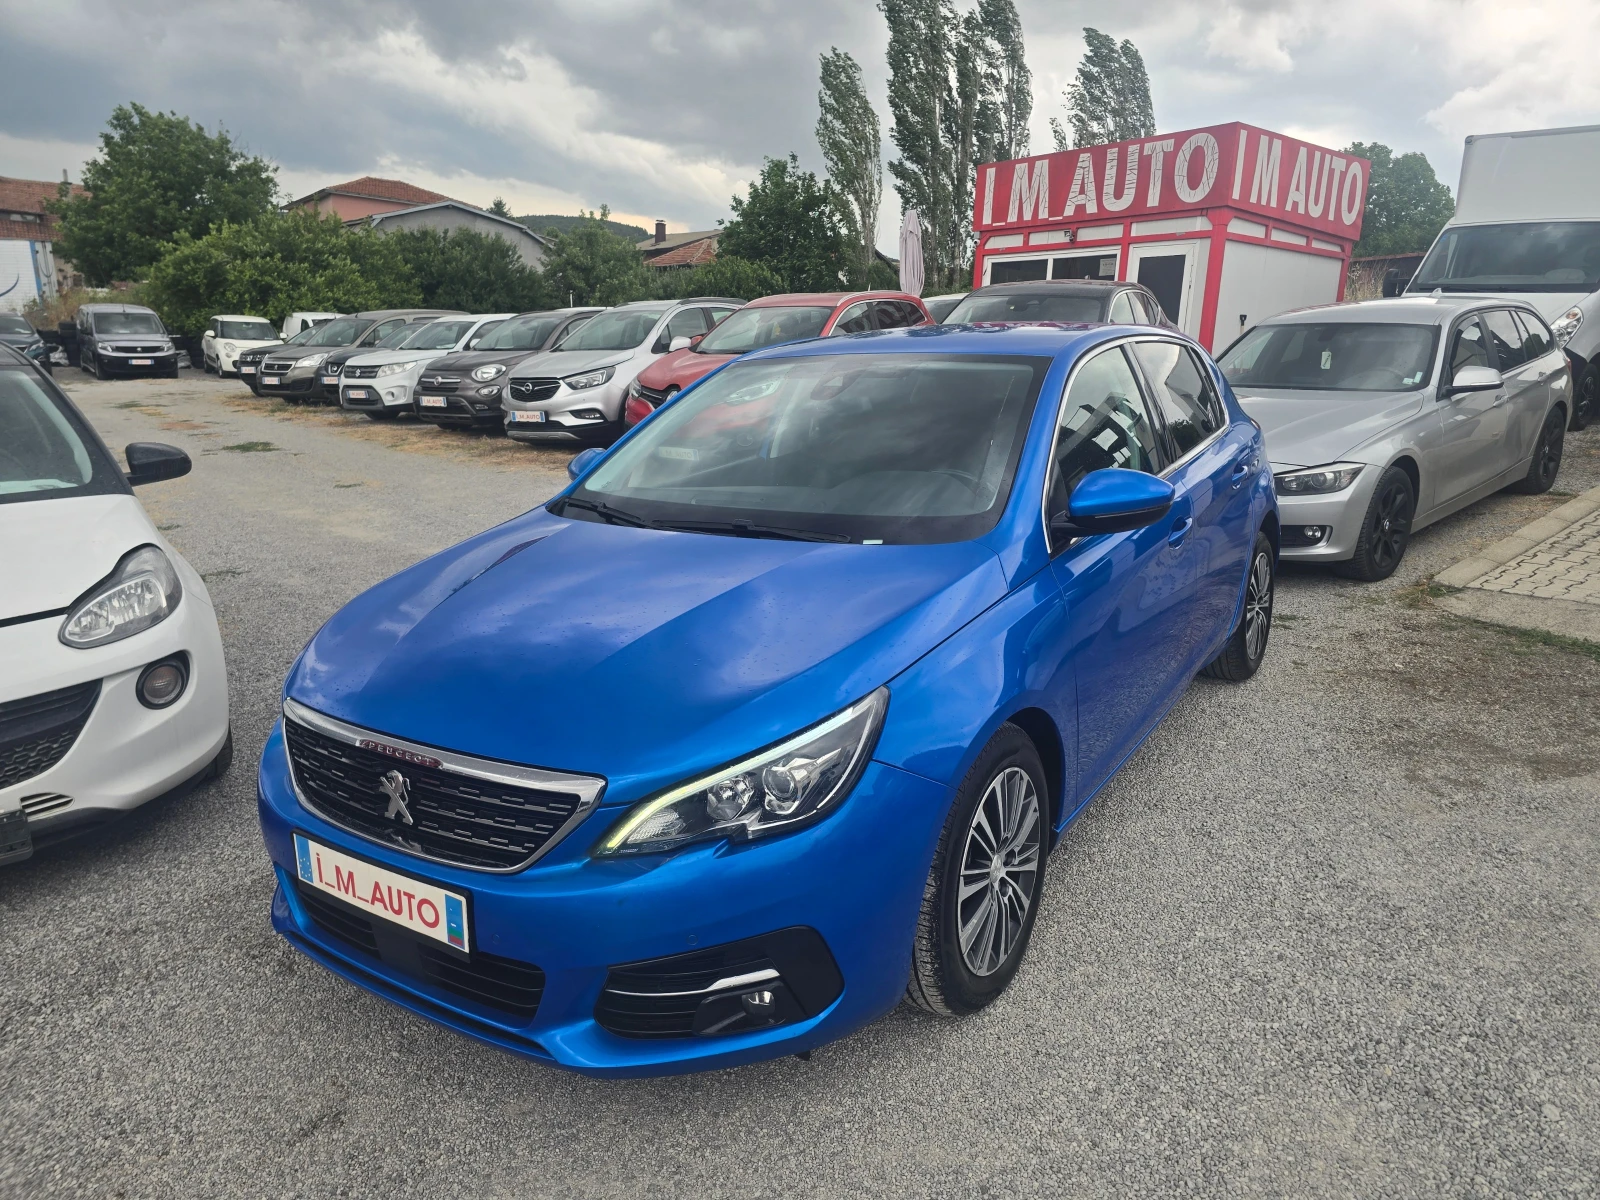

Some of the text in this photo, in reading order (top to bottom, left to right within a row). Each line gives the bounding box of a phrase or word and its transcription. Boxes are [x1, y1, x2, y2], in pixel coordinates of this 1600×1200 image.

[1249, 134, 1282, 208] M
[1285, 146, 1363, 226] AUTO
[368, 741, 434, 766] PEUGEOT
